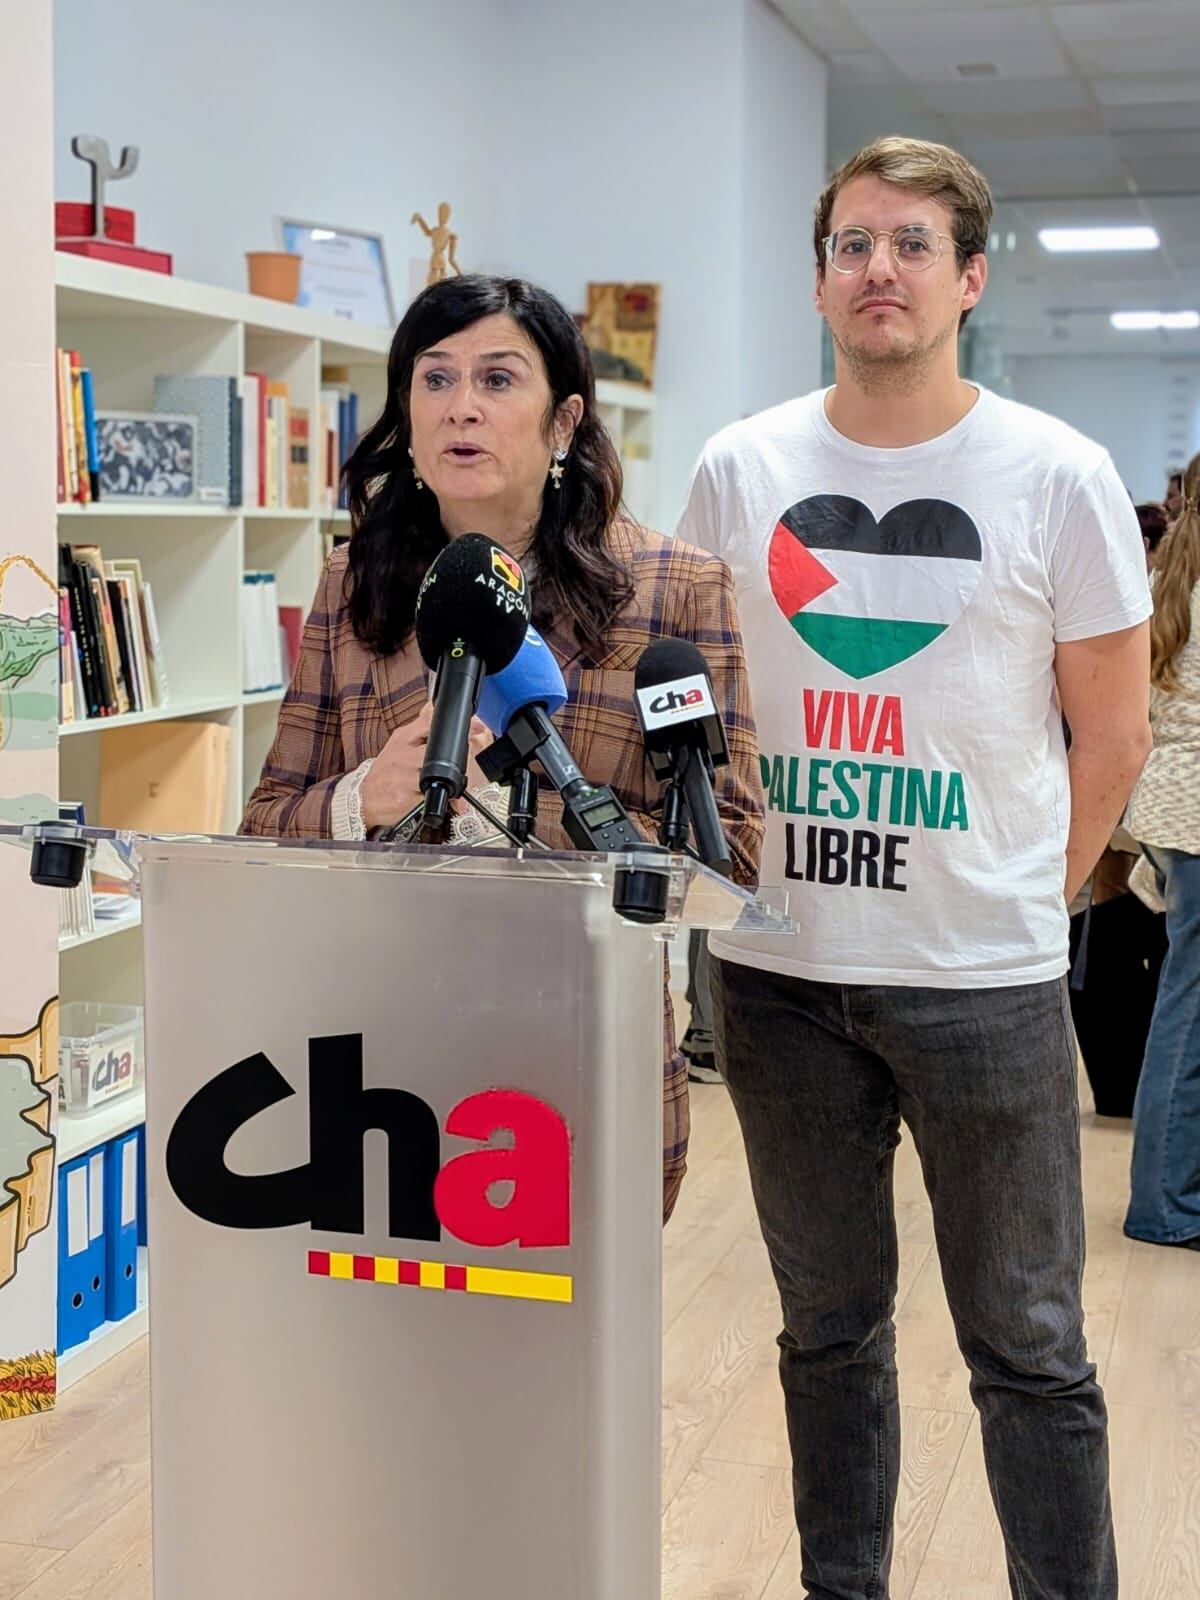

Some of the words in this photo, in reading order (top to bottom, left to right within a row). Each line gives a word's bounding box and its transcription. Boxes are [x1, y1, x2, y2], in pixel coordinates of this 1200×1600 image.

[496, 593, 515, 613] TV
[649, 688, 704, 714] cha
[803, 688, 904, 756] VIVA
[785, 823, 909, 892] LIBRE
[92, 1049, 133, 1091] cha
[166, 1033, 571, 1248] cha
